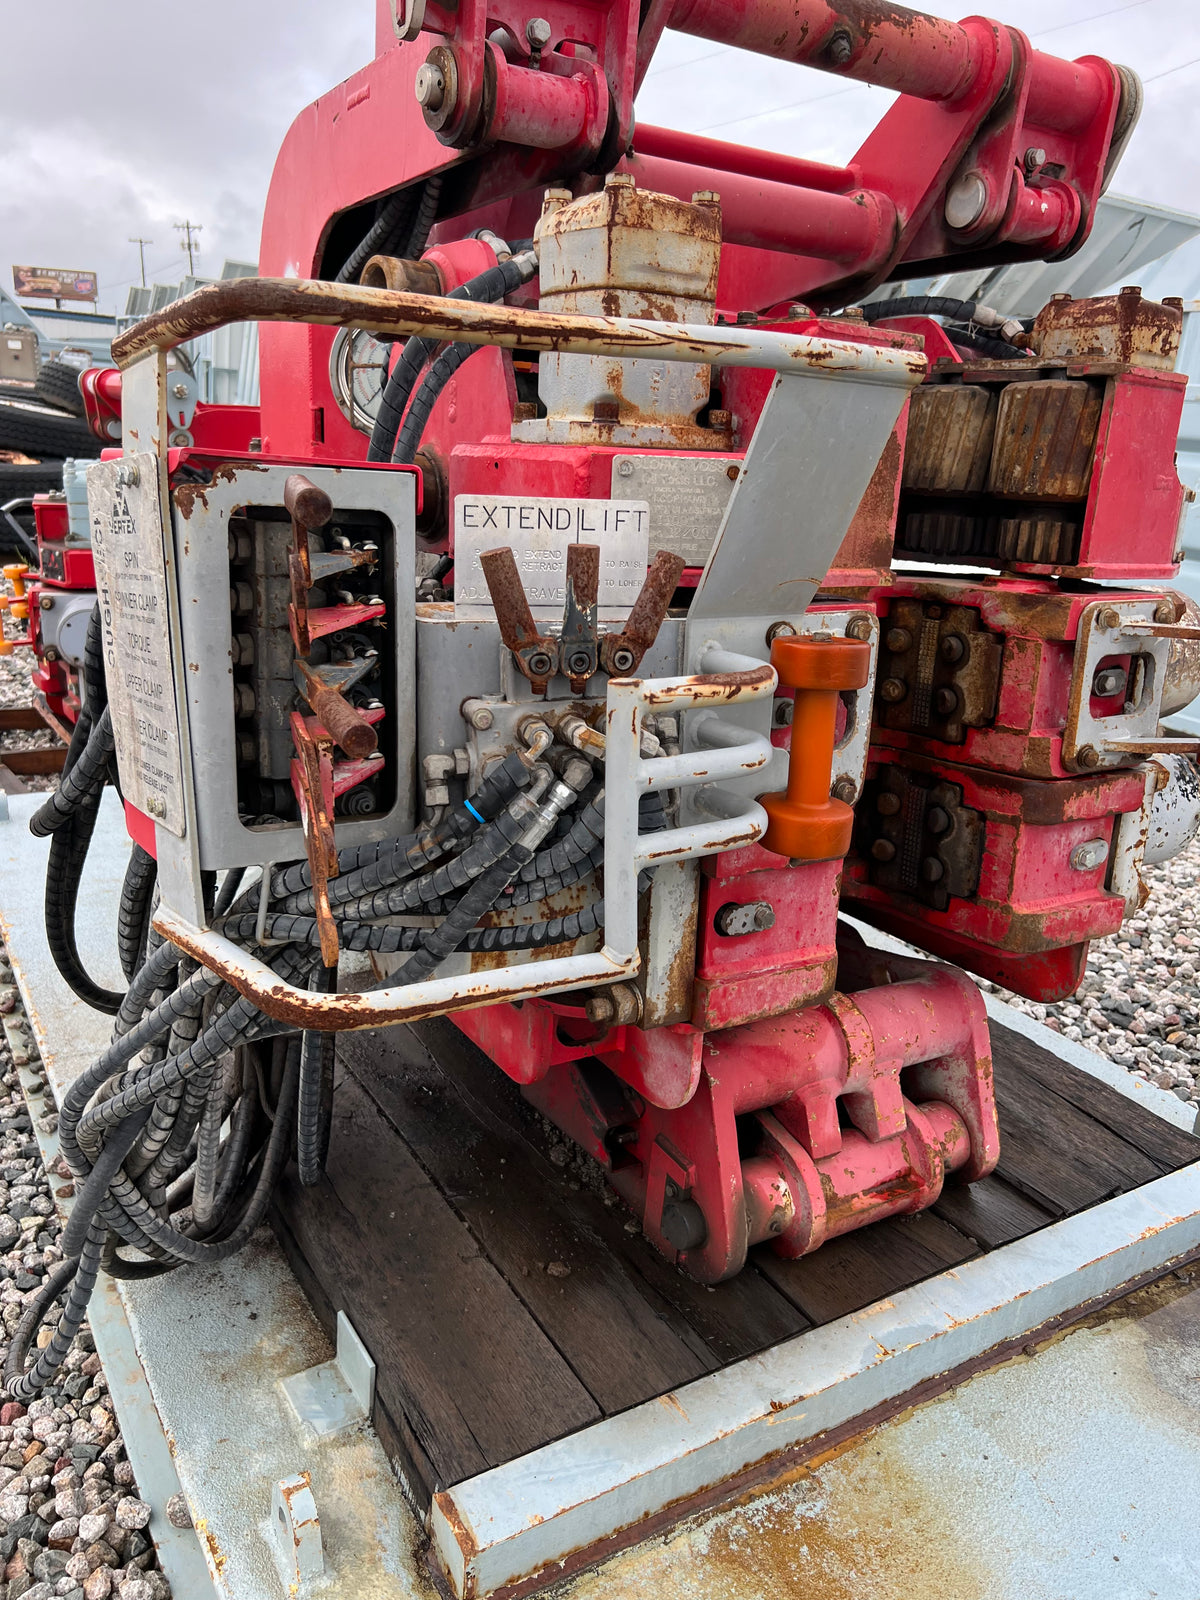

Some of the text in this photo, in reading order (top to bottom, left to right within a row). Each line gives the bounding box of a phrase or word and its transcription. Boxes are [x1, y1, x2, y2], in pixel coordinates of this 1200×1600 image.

[693, 461, 725, 473] VOSS
[108, 518, 136, 535] VERTEX
[463, 504, 571, 530] EXTEND
[581, 509, 647, 532] LIFT
[124, 551, 139, 569] SPIN
[524, 549, 562, 560] EXTEND
[521, 561, 564, 572] RETRACT
[605, 560, 615, 569] TO
[604, 579, 643, 588] TO LOWER
[523, 586, 564, 600] TRAVE
[138, 593, 157, 612] CLAMP
[127, 632, 151, 654] TORQUE
[124, 672, 163, 700] UPPER CLAMP
[147, 722, 168, 745] CLAMP
